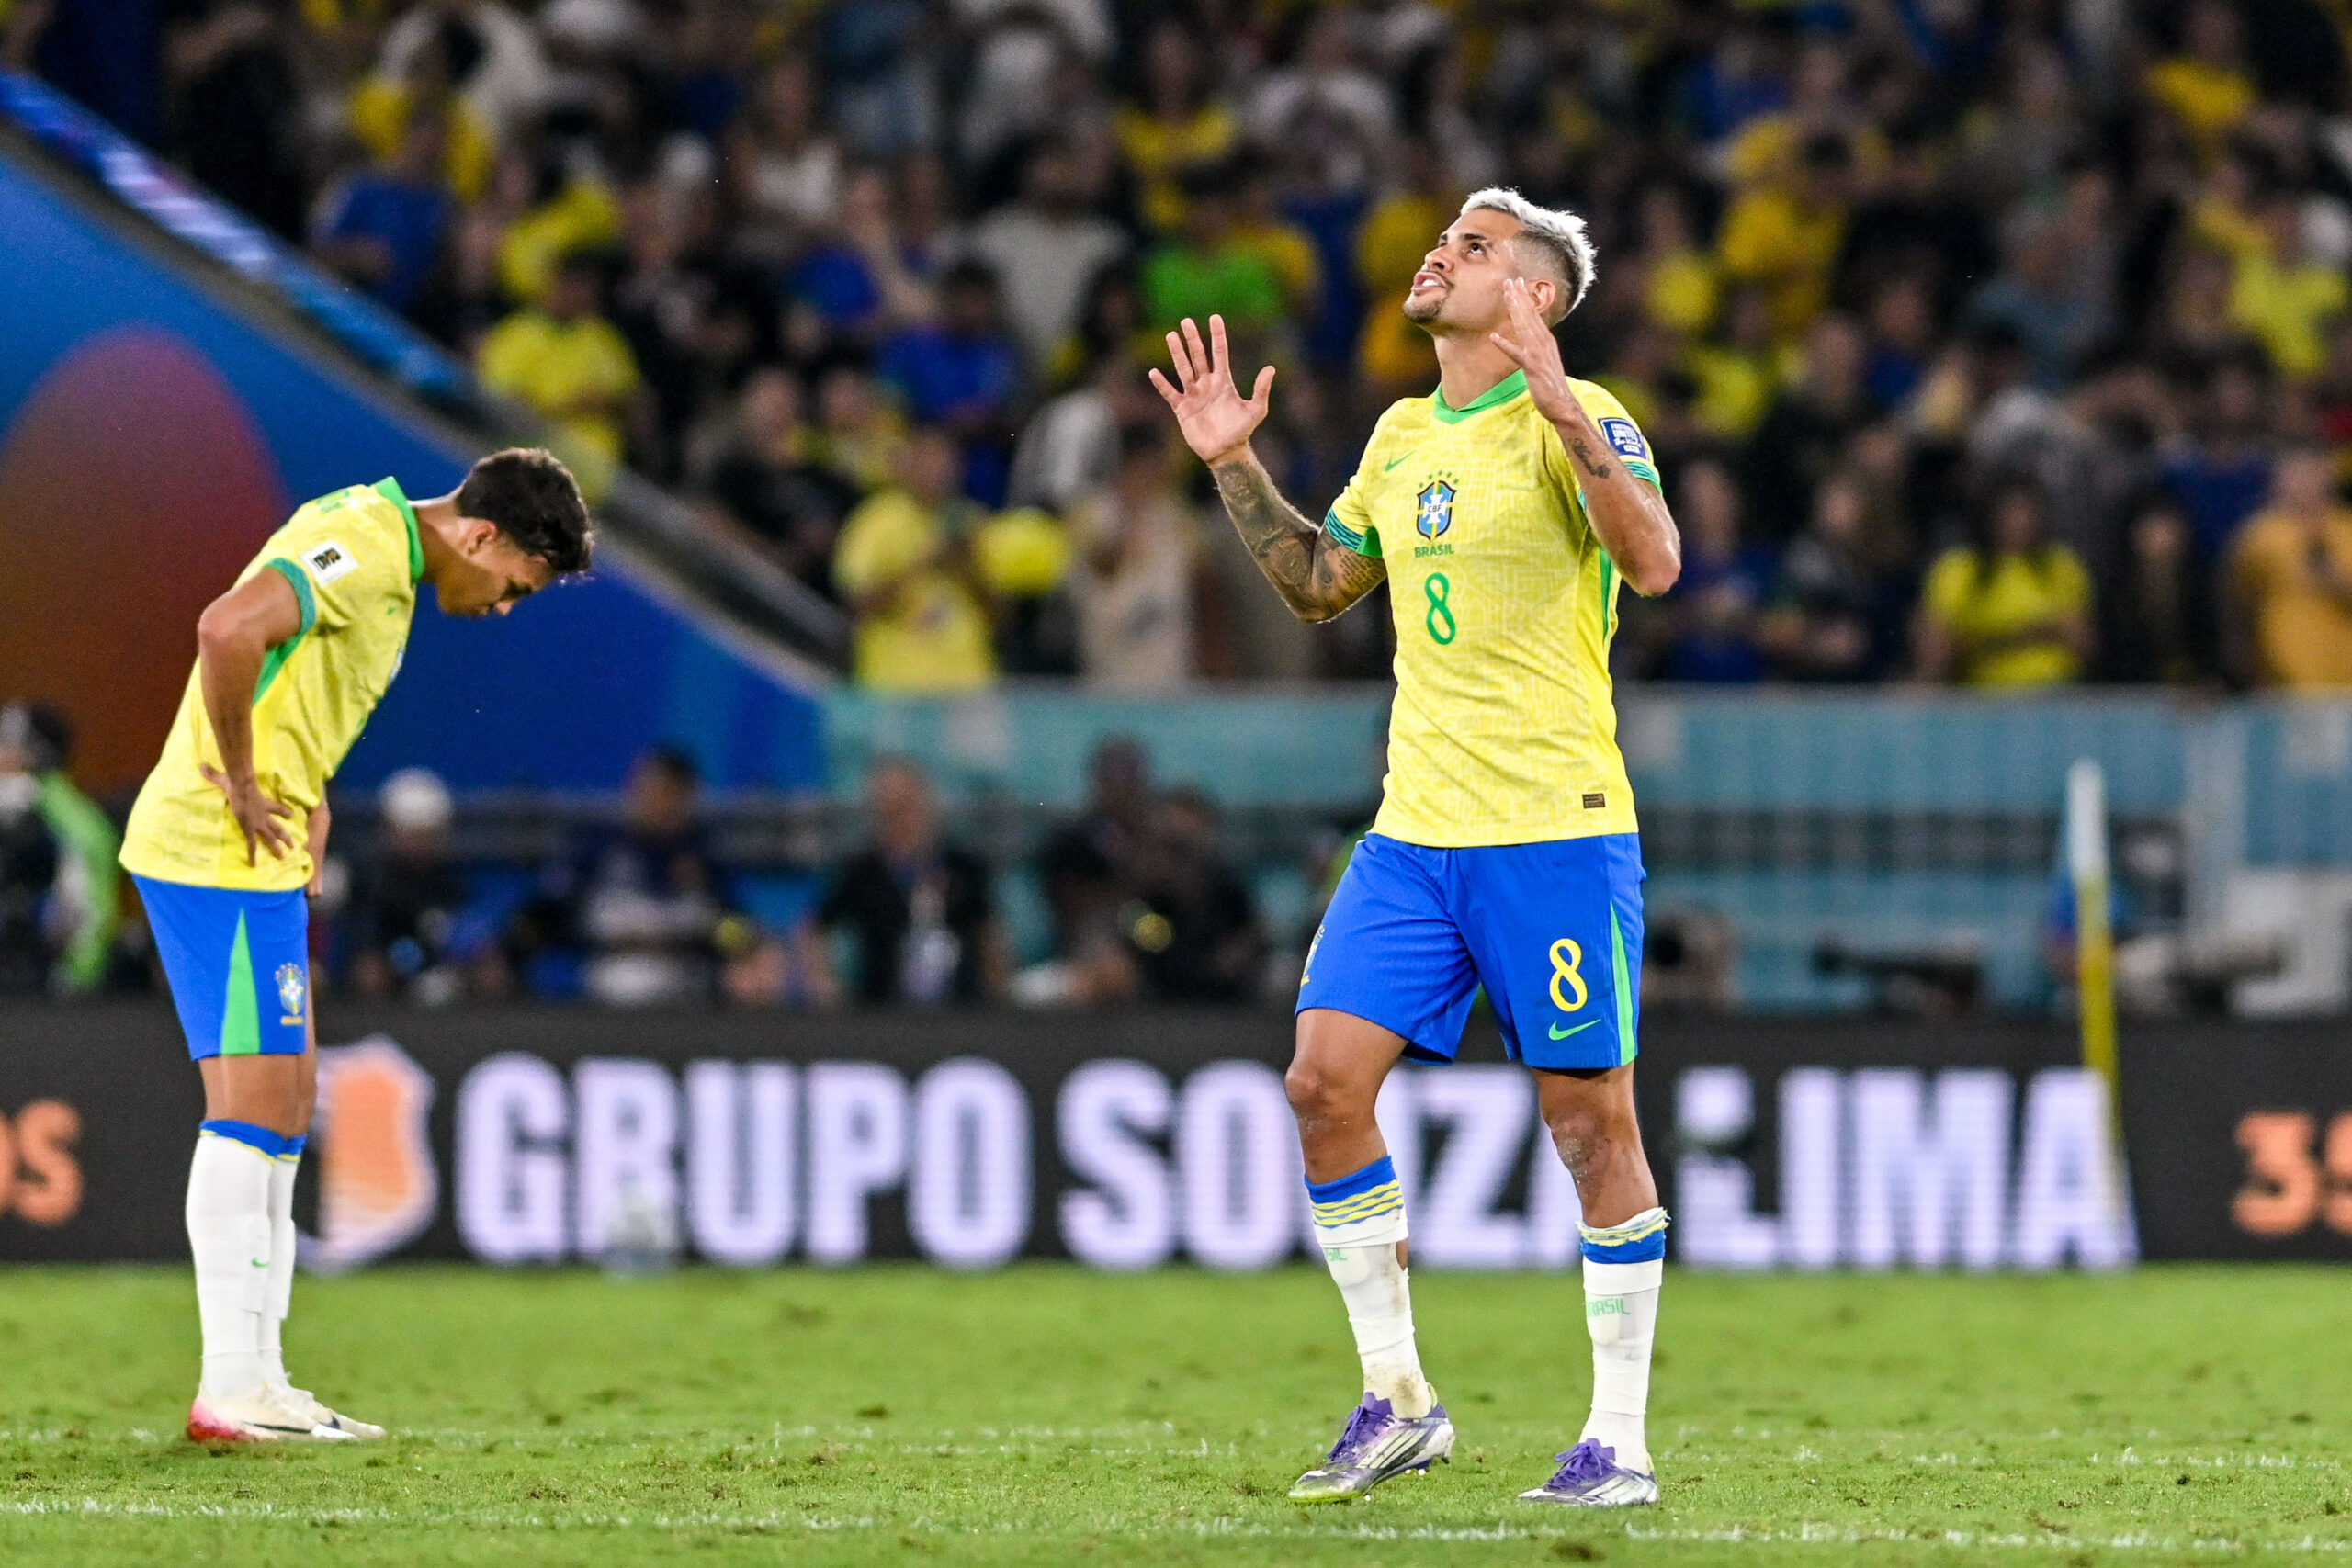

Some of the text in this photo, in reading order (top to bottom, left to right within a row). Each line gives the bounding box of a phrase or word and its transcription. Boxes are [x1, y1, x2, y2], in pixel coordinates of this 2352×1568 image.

[1428, 504, 1442, 513] CBF
[1414, 544, 1454, 558] BRASIL
[1425, 572, 1456, 645] 8
[1549, 938, 1588, 1011] 8
[0, 1099, 83, 1224] S
[457, 1053, 2140, 1269] GRUPO SOZ LIMA
[1587, 1298, 1631, 1317] RASIL
